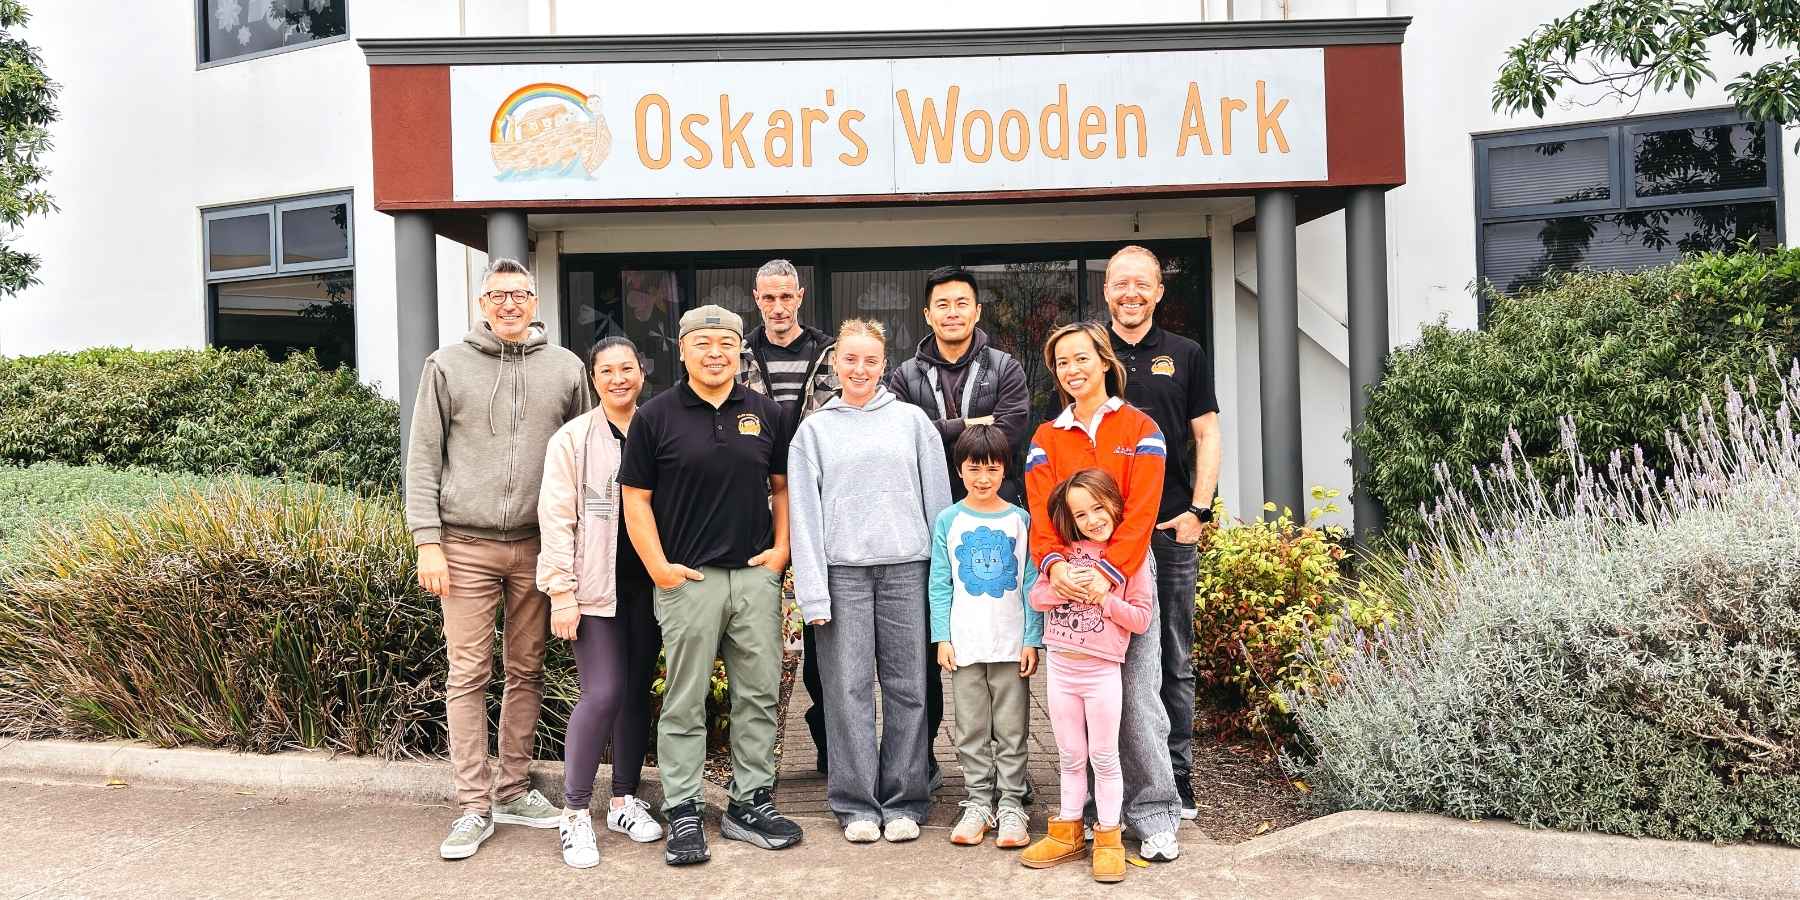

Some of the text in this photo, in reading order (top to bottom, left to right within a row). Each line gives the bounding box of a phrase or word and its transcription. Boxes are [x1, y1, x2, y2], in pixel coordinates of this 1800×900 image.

[635, 79, 1291, 170] Oskar's Wooden Ark
